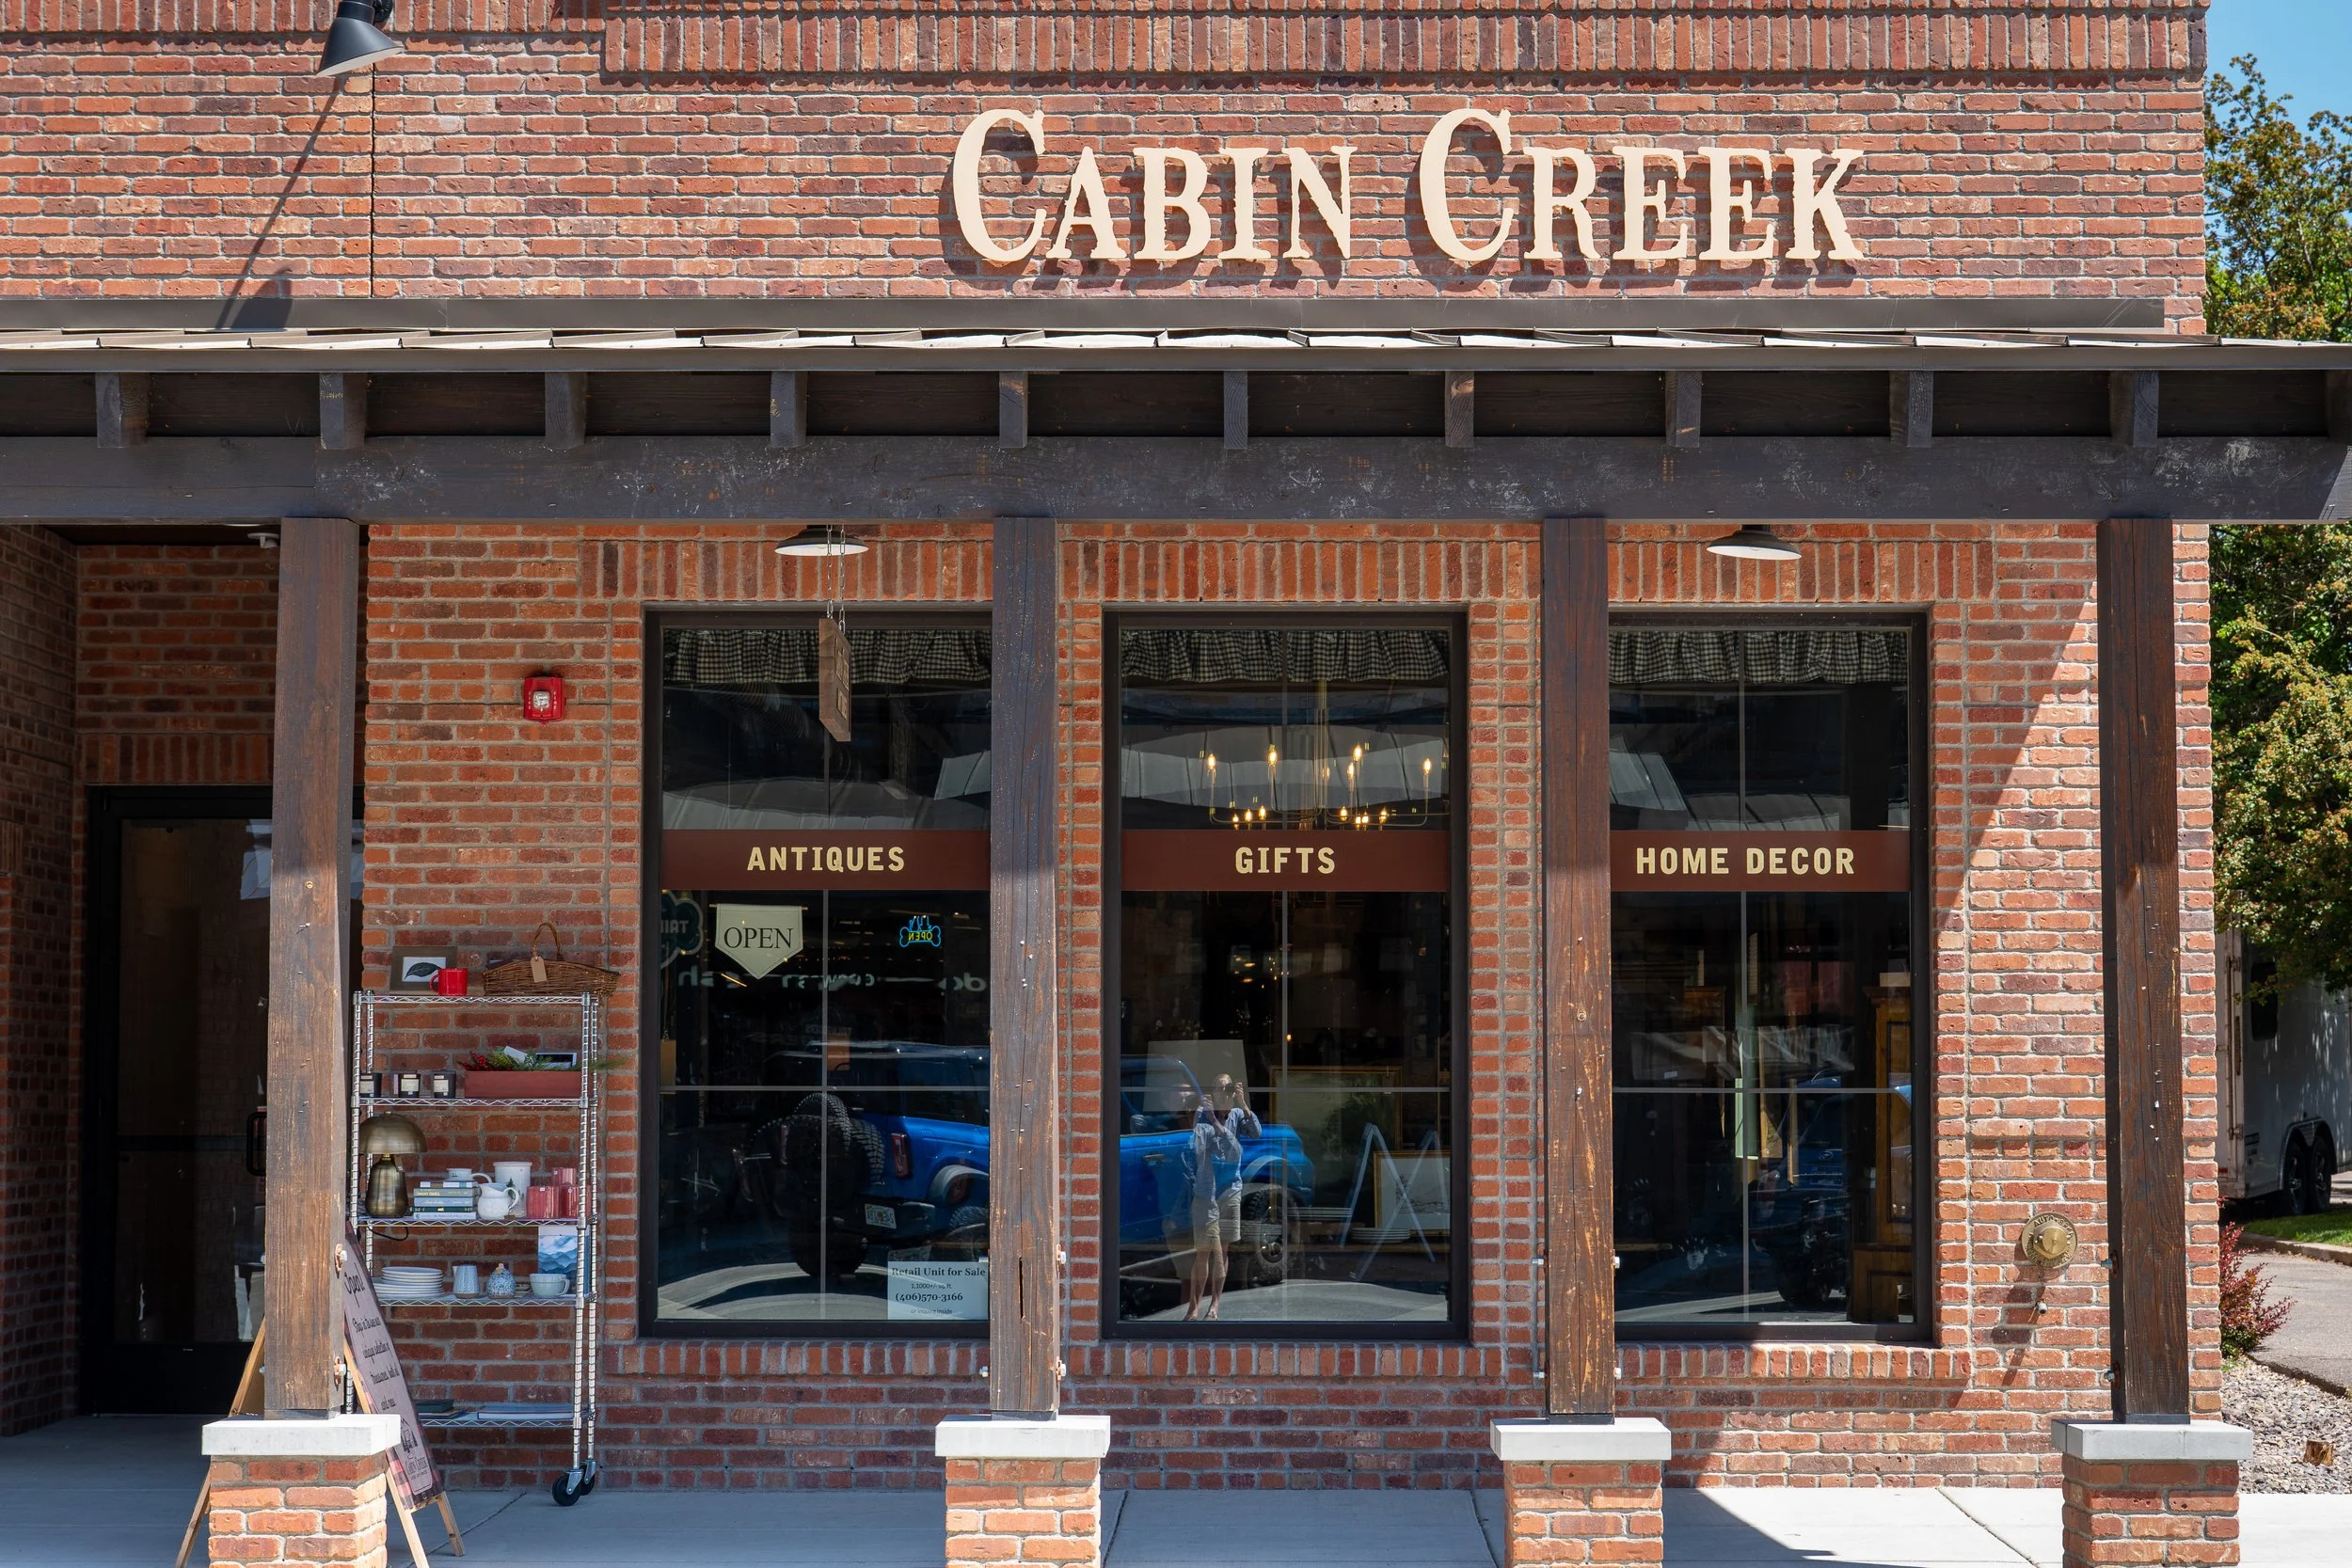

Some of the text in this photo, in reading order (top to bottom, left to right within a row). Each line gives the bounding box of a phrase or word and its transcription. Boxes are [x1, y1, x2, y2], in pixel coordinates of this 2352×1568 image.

[952, 108, 1864, 261] CABIN CREEK
[747, 847, 905, 873] ANTIQUES
[1235, 847, 1335, 874] GIFTS
[1636, 847, 1854, 875] HOME DECOR
[723, 927, 794, 949] OPEN
[892, 1267, 986, 1276] Retail Unit for Sale
[895, 1292, 963, 1303] (406)570-3166
